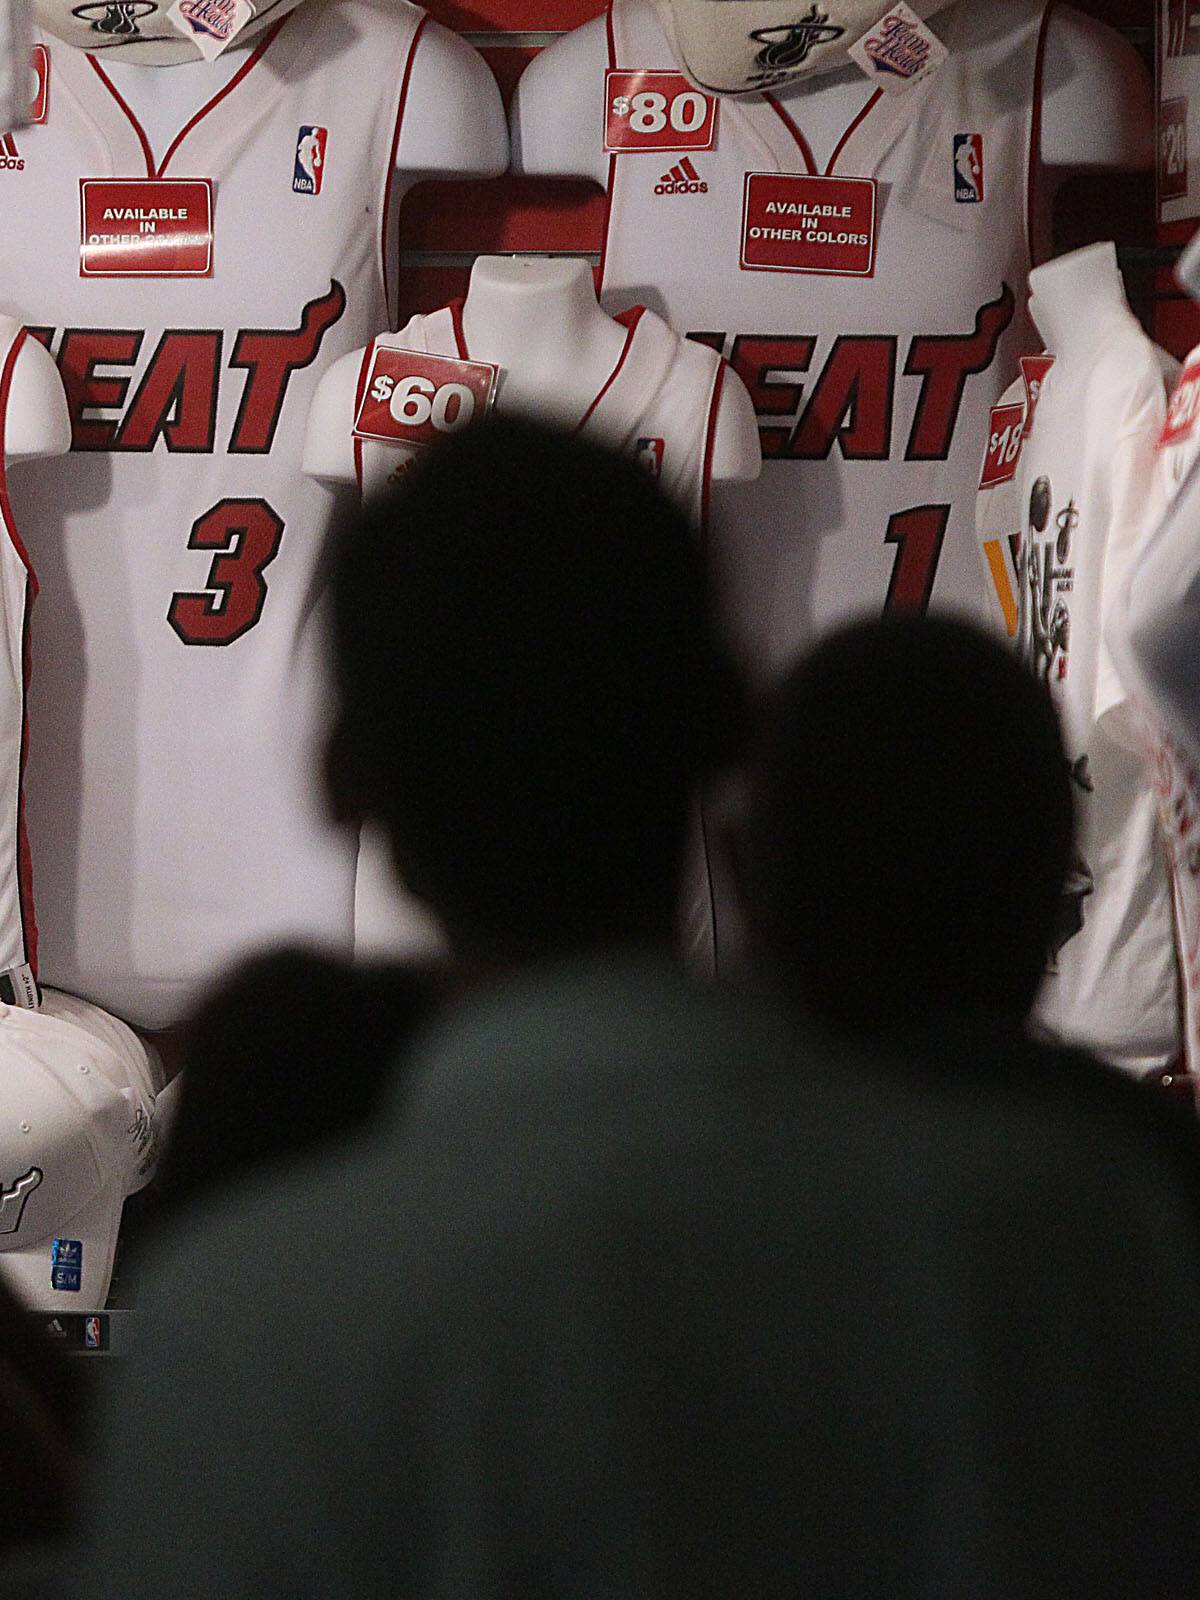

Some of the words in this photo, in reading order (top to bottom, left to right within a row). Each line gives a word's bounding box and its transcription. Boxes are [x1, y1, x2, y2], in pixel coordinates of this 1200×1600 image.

[612, 91, 708, 133] $80
[293, 177, 312, 190] NBA
[654, 180, 709, 195] adidas
[956, 188, 975, 199] NBA
[103, 208, 188, 220] AVAILABLE
[765, 201, 852, 218] AVAILABLE
[139, 221, 156, 233] IN
[801, 217, 819, 229] IN
[89, 234, 141, 246] OTHER
[749, 227, 802, 241] OTHER
[805, 231, 869, 245] COLORS
[24, 278, 347, 454] EAT
[685, 280, 1016, 461] EAT
[370, 374, 475, 432] $60
[989, 421, 1023, 467] $18
[883, 503, 951, 620] 1
[166, 497, 285, 646] 3
